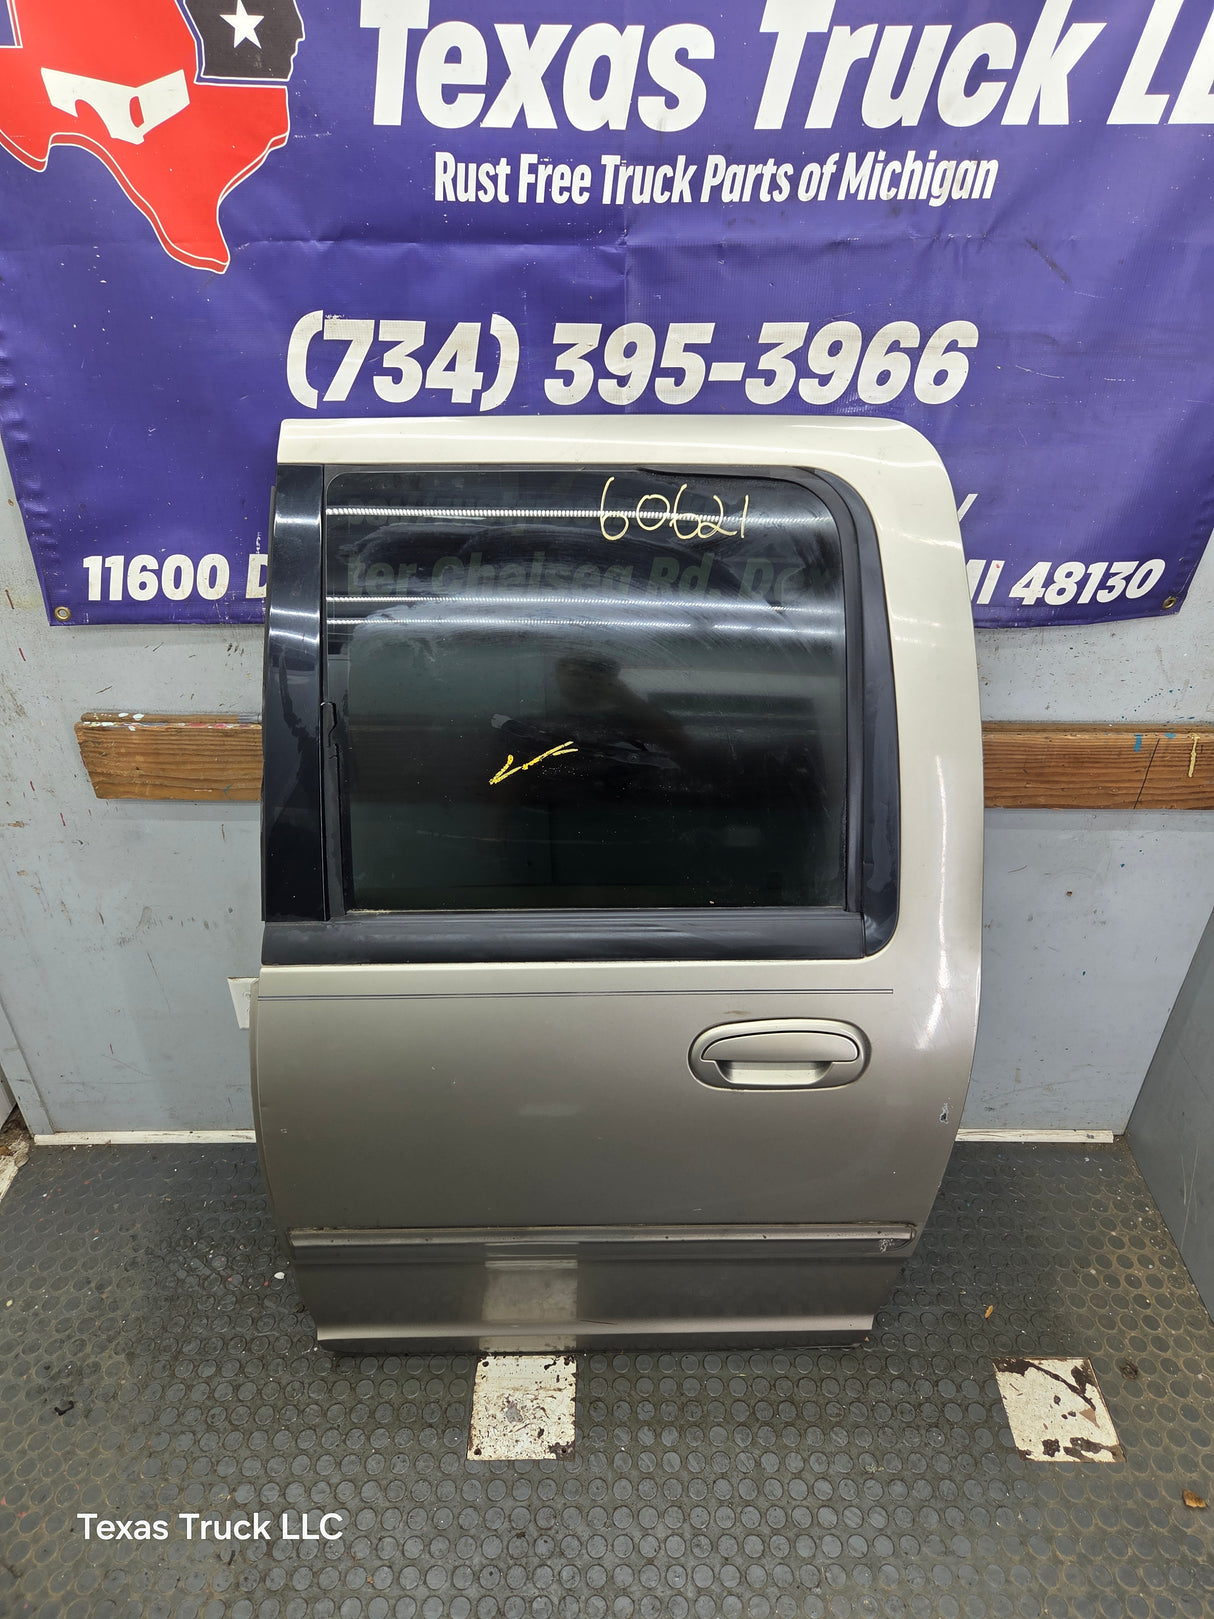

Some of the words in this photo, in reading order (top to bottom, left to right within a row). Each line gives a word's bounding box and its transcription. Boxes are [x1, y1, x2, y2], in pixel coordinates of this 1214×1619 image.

[360, 0, 716, 132] Texas
[753, 0, 1107, 130] Truck
[434, 151, 511, 203] Rust
[517, 153, 592, 205] Free
[600, 154, 698, 205] Truck
[699, 154, 794, 203] Parts
[797, 152, 840, 202] of
[837, 150, 999, 207] Michigan
[286, 310, 520, 412] (734)
[544, 320, 979, 406] 395-3966
[600, 476, 750, 541] 60621
[83, 553, 230, 601] 11600
[1008, 559, 1166, 606] 48130
